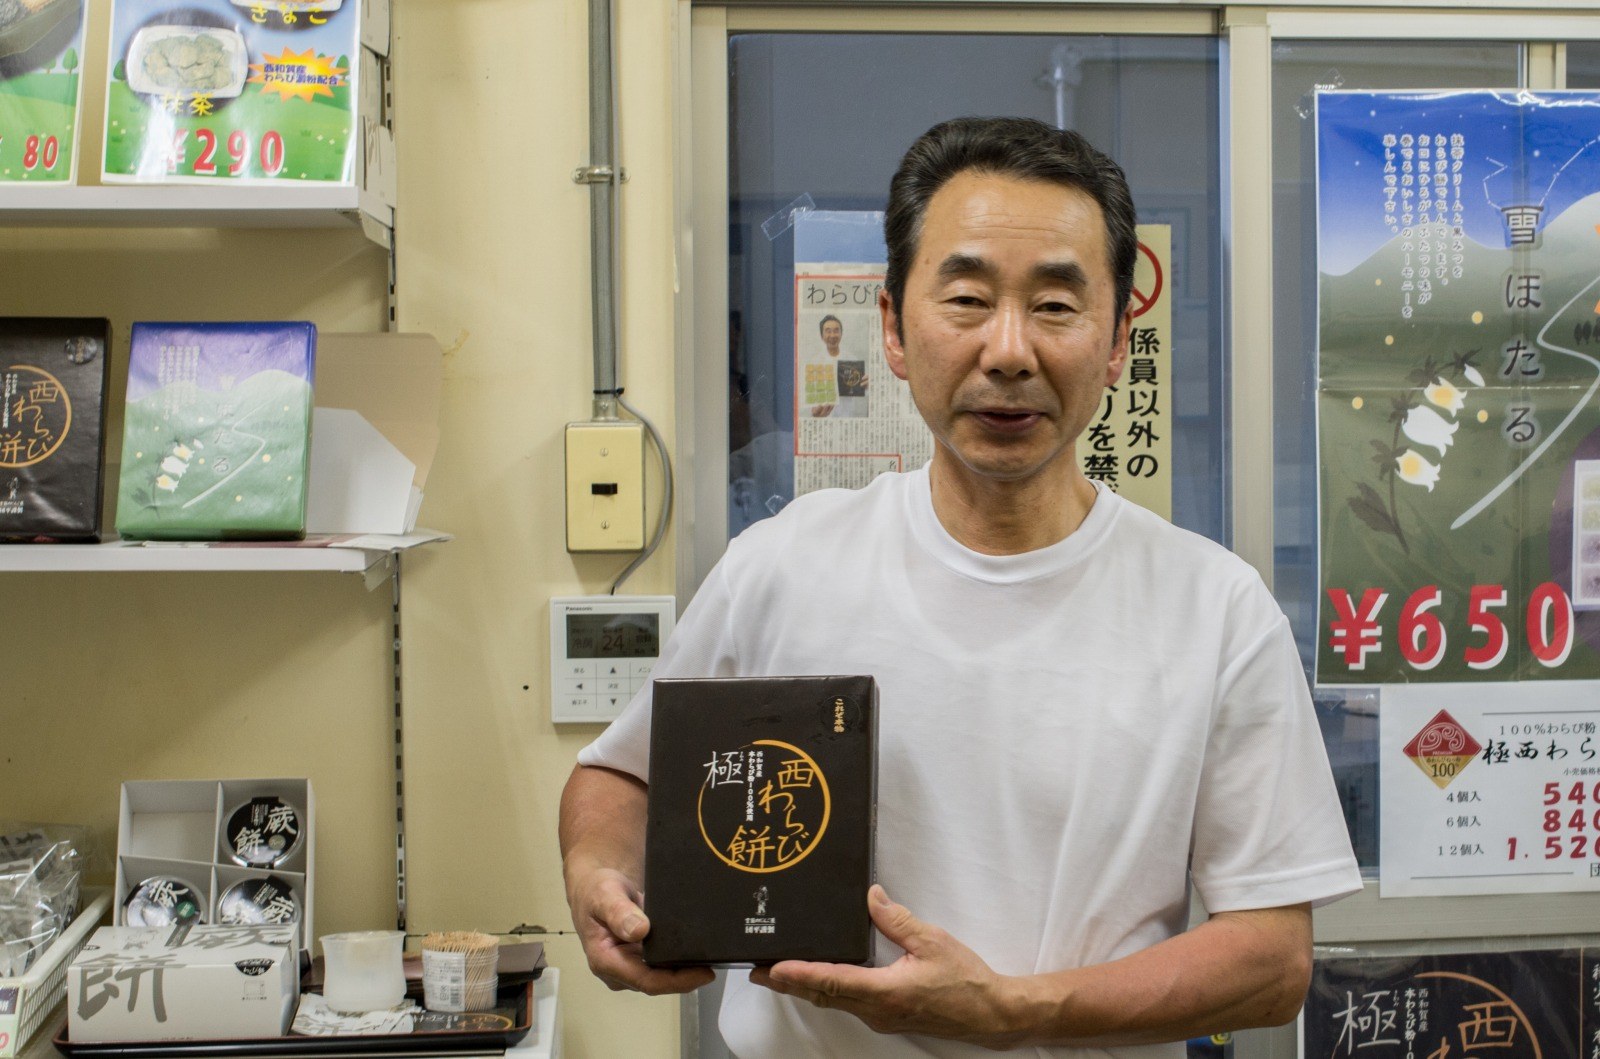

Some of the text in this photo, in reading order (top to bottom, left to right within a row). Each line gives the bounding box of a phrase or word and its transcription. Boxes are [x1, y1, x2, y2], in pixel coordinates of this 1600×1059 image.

[250, 5, 328, 25] きなこ
[1500, 205, 1545, 444] 雪ほたる
[1126, 326, 1161, 479] 係員以外の
[1326, 581, 1575, 671] ¥650
[704, 751, 744, 789] 極
[1446, 790, 1482, 803] 4個入
[1446, 815, 1482, 828] 6個入
[1438, 843, 1485, 857] 12個入
[1332, 990, 1401, 1056] 極
